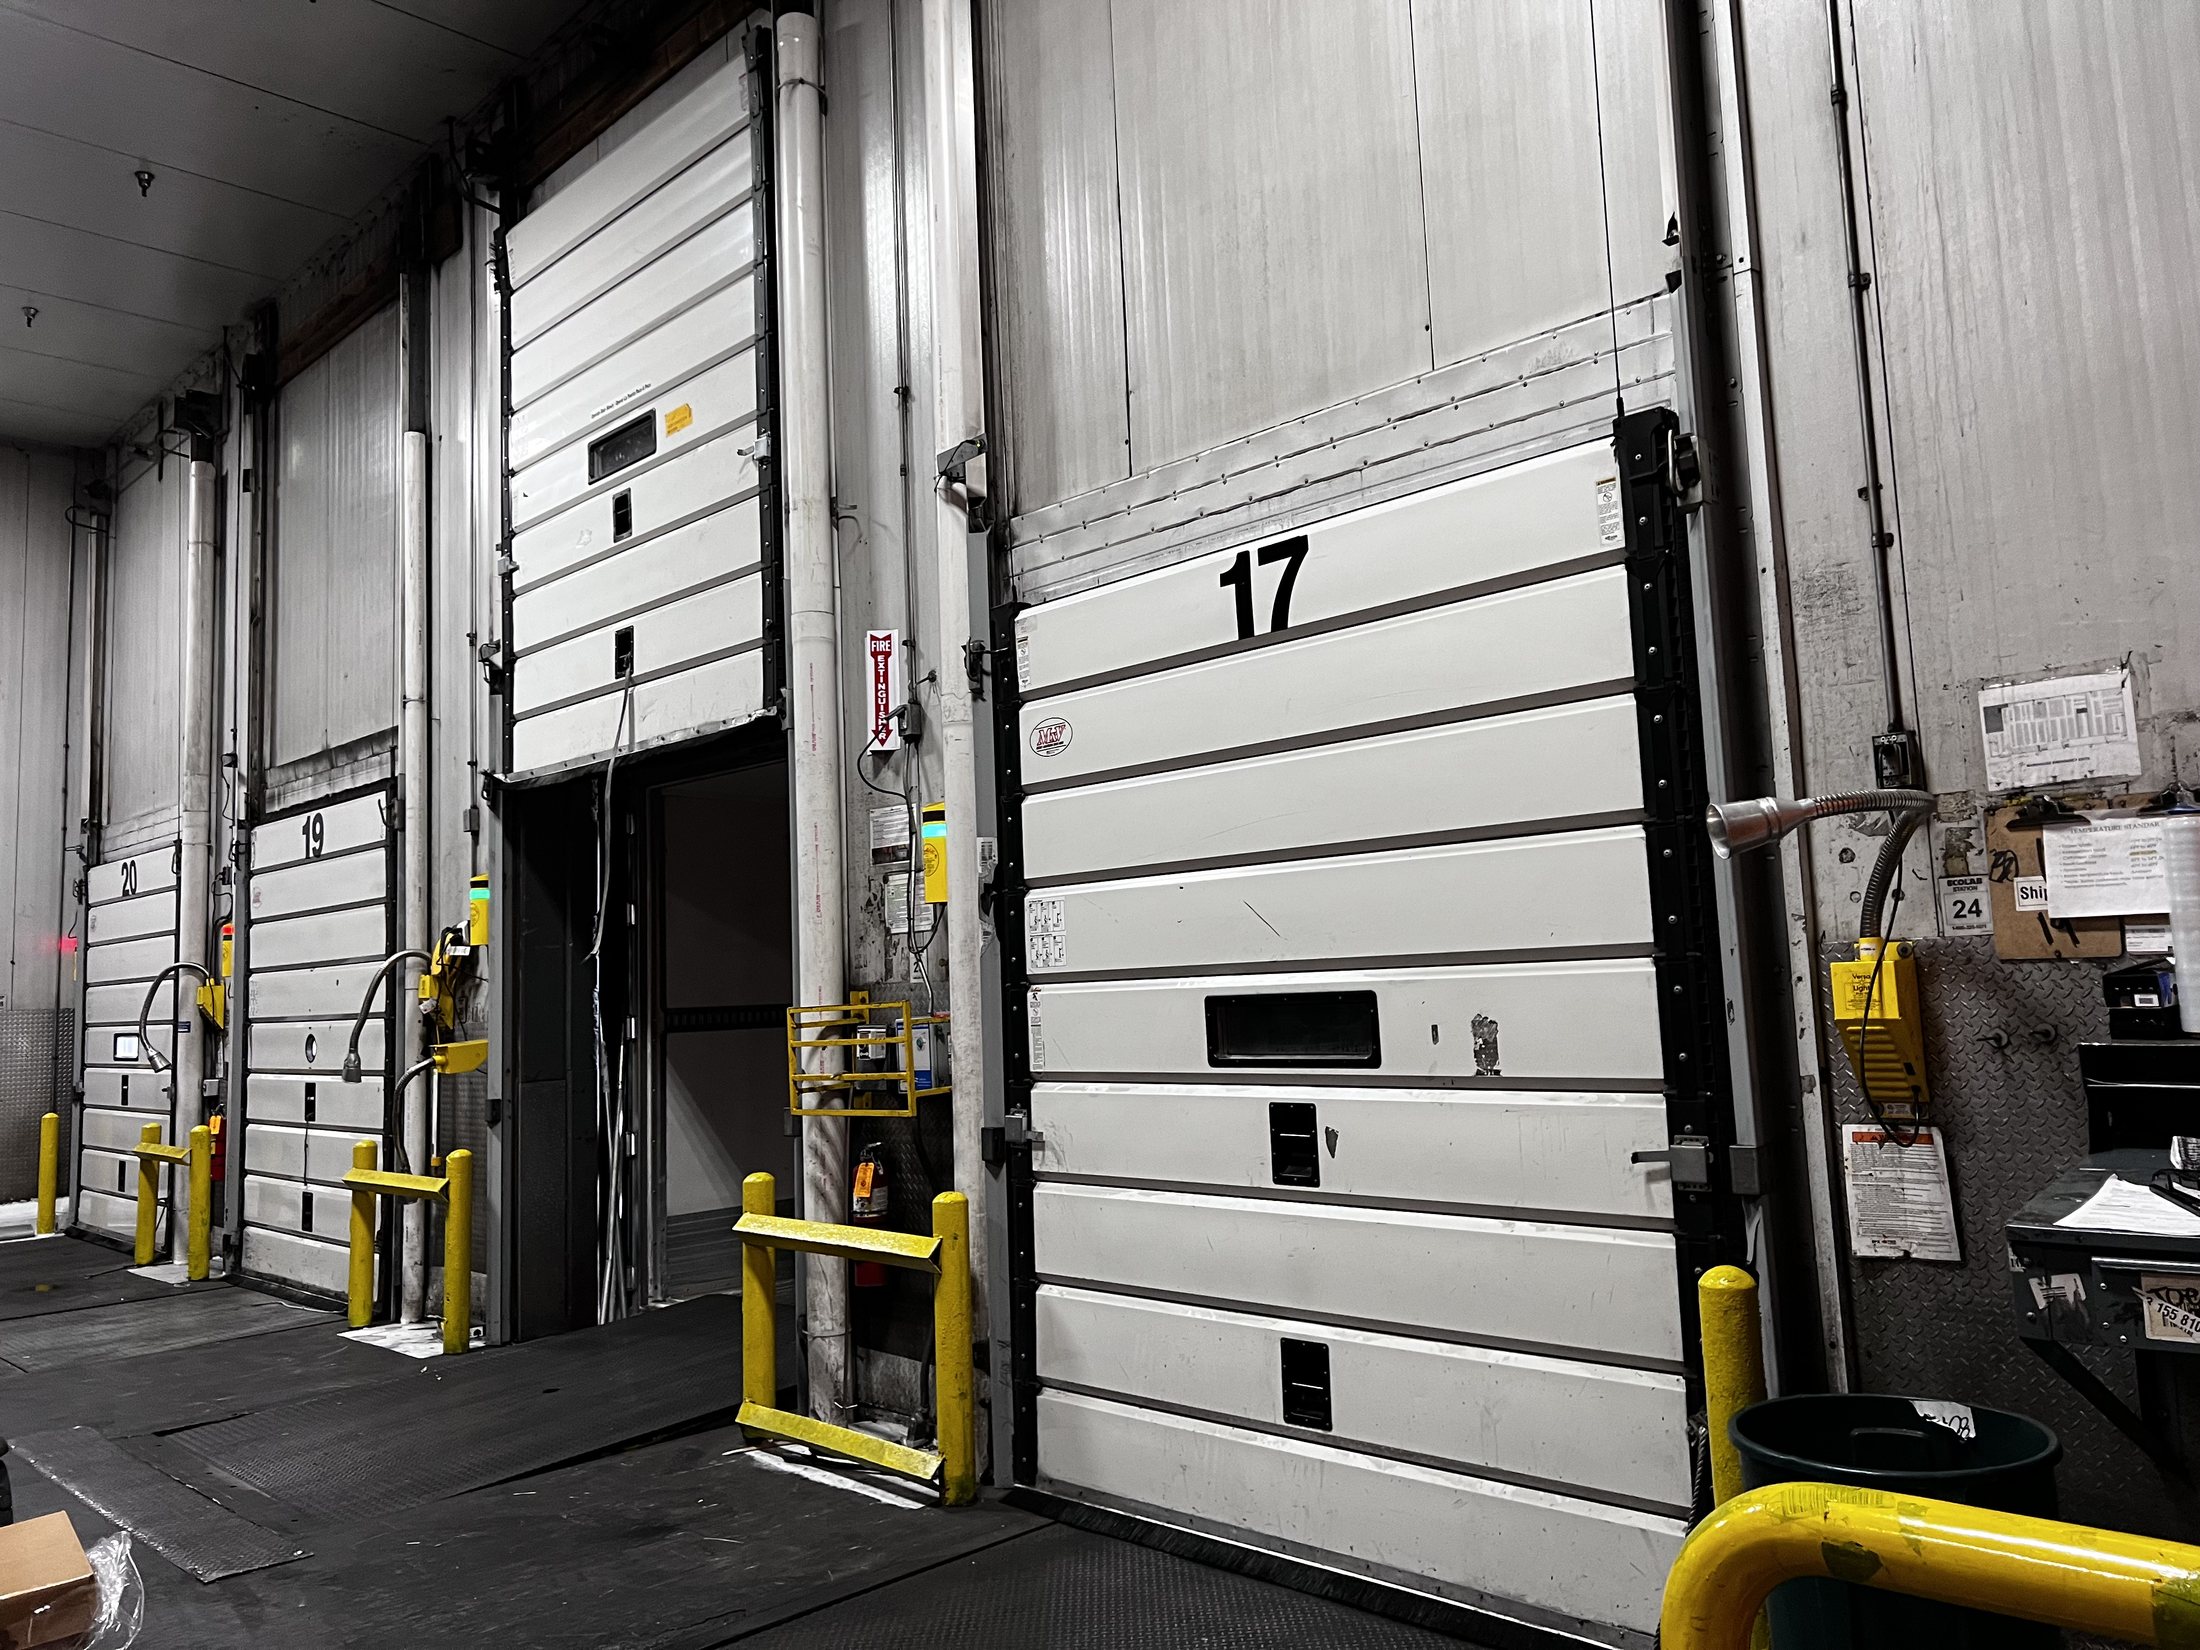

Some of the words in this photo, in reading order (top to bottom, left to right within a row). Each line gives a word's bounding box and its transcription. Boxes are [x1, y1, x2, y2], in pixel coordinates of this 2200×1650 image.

[1220, 534, 1309, 640] 17
[871, 640, 891, 652] FIRE
[302, 812, 324, 859] 19
[2070, 825, 2121, 834] TEMPERATURE
[121, 860, 137, 897] 20
[1946, 878, 1983, 887] ECOLAB
[1952, 898, 1982, 919] 24
[2157, 1303, 2179, 1320] 155
